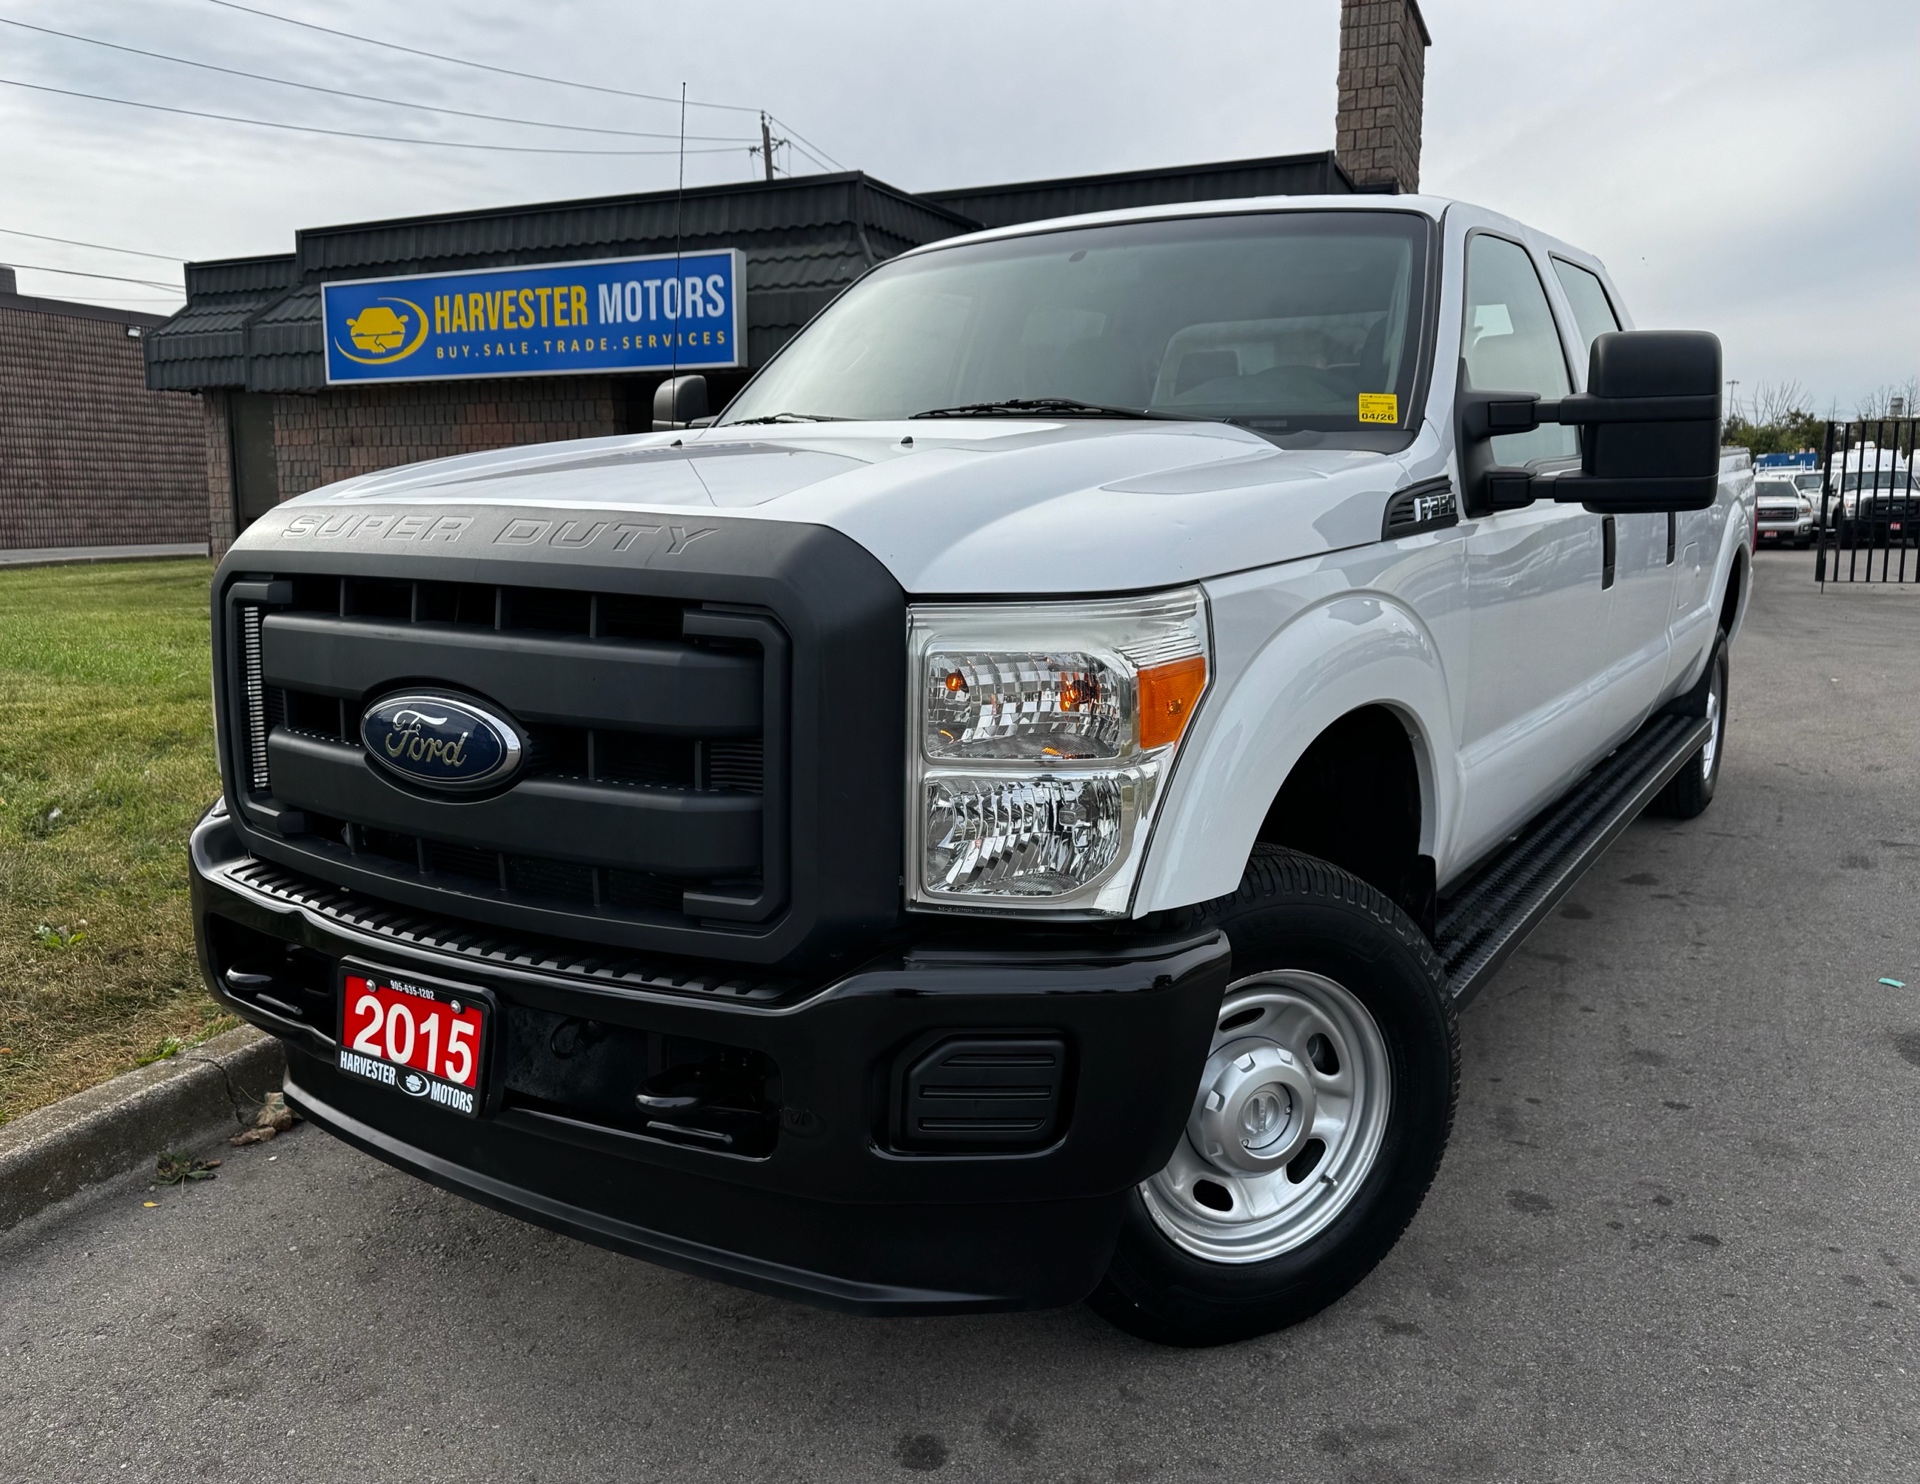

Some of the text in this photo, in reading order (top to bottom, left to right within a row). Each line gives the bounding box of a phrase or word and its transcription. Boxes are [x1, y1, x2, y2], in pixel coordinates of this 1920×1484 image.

[435, 274, 726, 334] HARVESTER MOTORS
[1361, 412, 1394, 421] 04/26
[281, 513, 721, 555] SUPER DUTY
[385, 709, 469, 768] Ford
[390, 980, 435, 1001] 905-635-1202
[352, 994, 475, 1084] 2015
[340, 1050, 474, 1114] HARVESTER MOTORS
